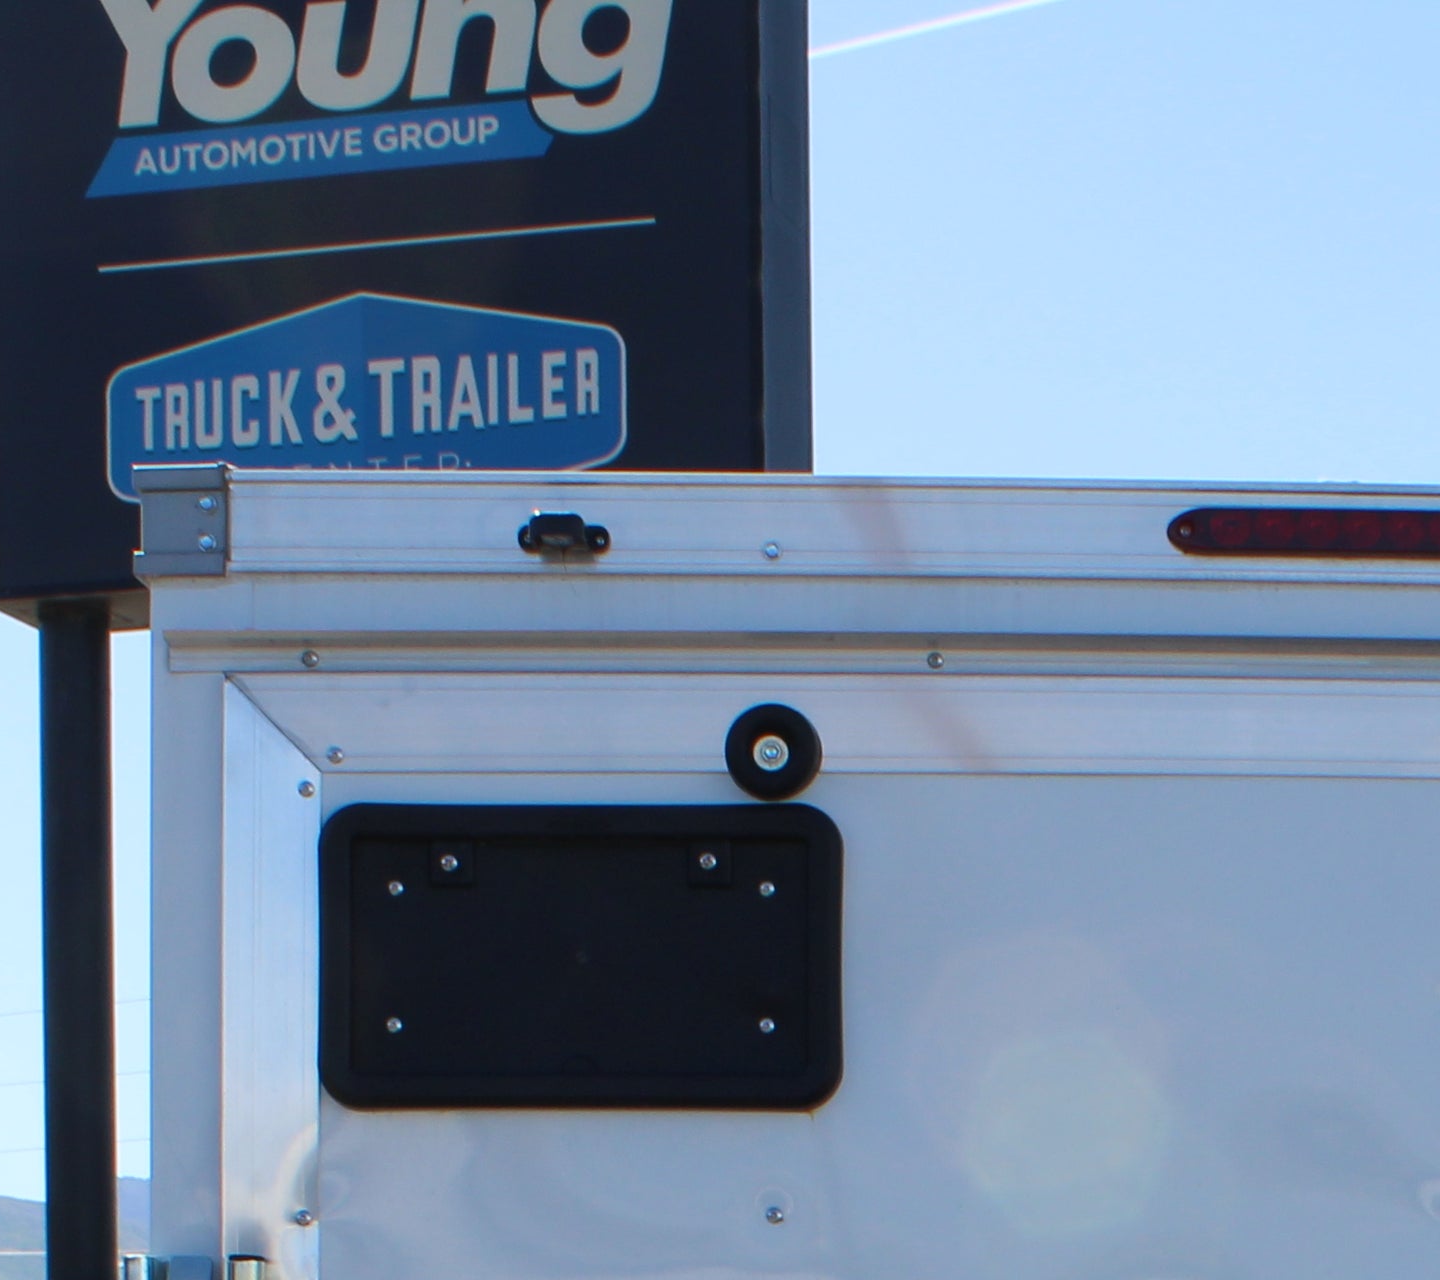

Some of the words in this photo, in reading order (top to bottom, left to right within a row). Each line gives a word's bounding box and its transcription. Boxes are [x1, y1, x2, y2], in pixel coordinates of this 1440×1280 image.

[97, 0, 674, 134] Young
[133, 126, 364, 177] AUTOMOTIVE
[372, 115, 501, 154] GROUP
[135, 368, 303, 455] TRUCK
[367, 346, 601, 440] TRAILER
